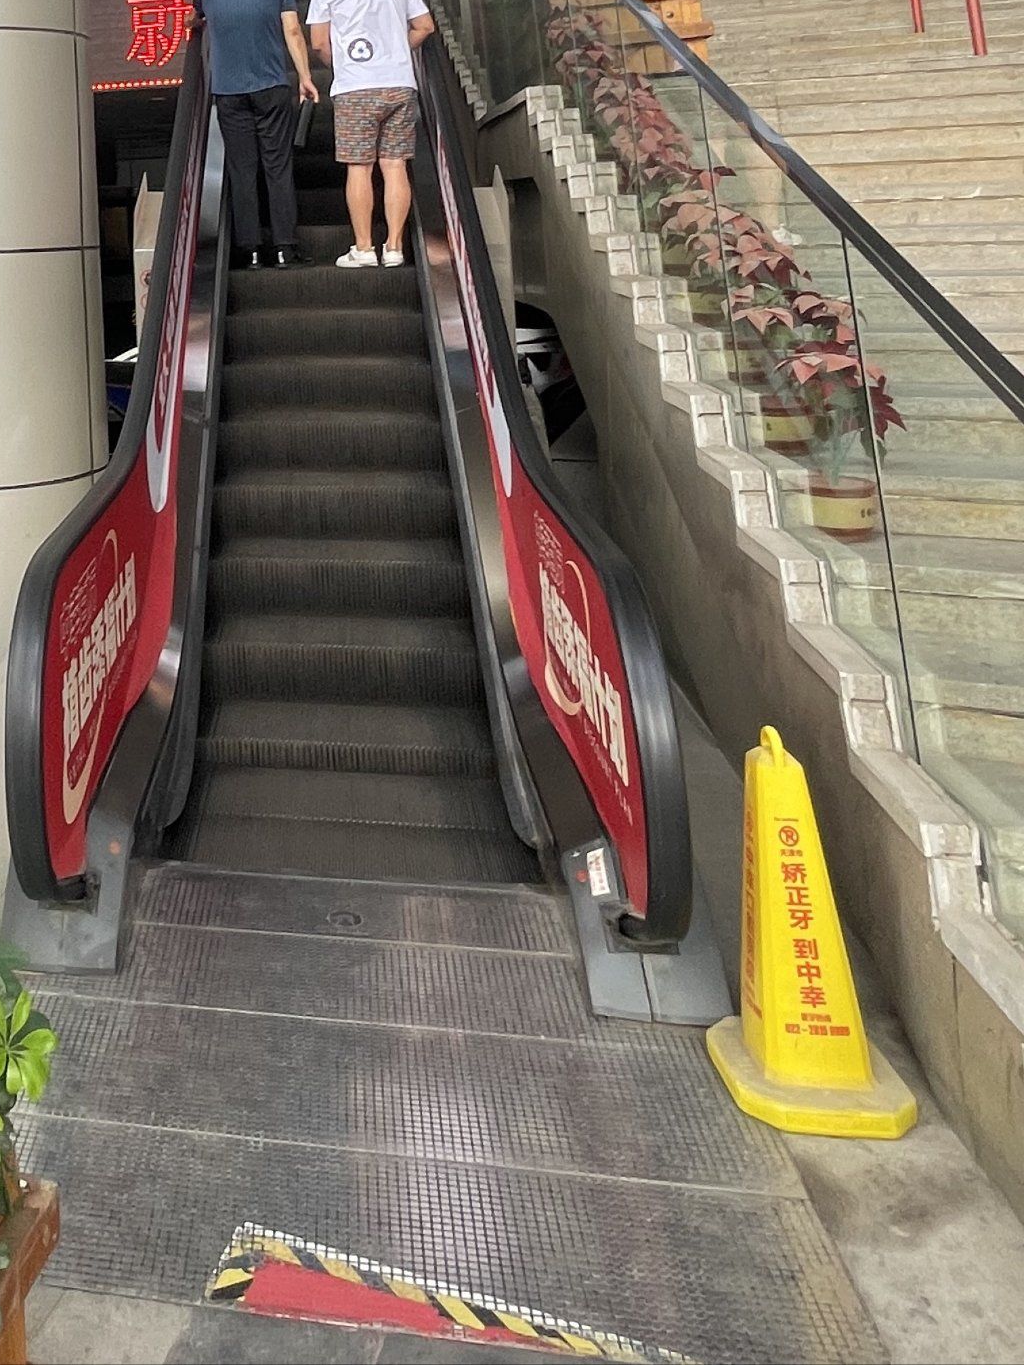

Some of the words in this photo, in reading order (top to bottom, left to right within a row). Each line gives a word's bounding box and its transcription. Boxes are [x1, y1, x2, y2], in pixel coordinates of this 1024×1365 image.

[781, 861, 814, 931] 矫正牙
[792, 938, 827, 1009] 到中幸
